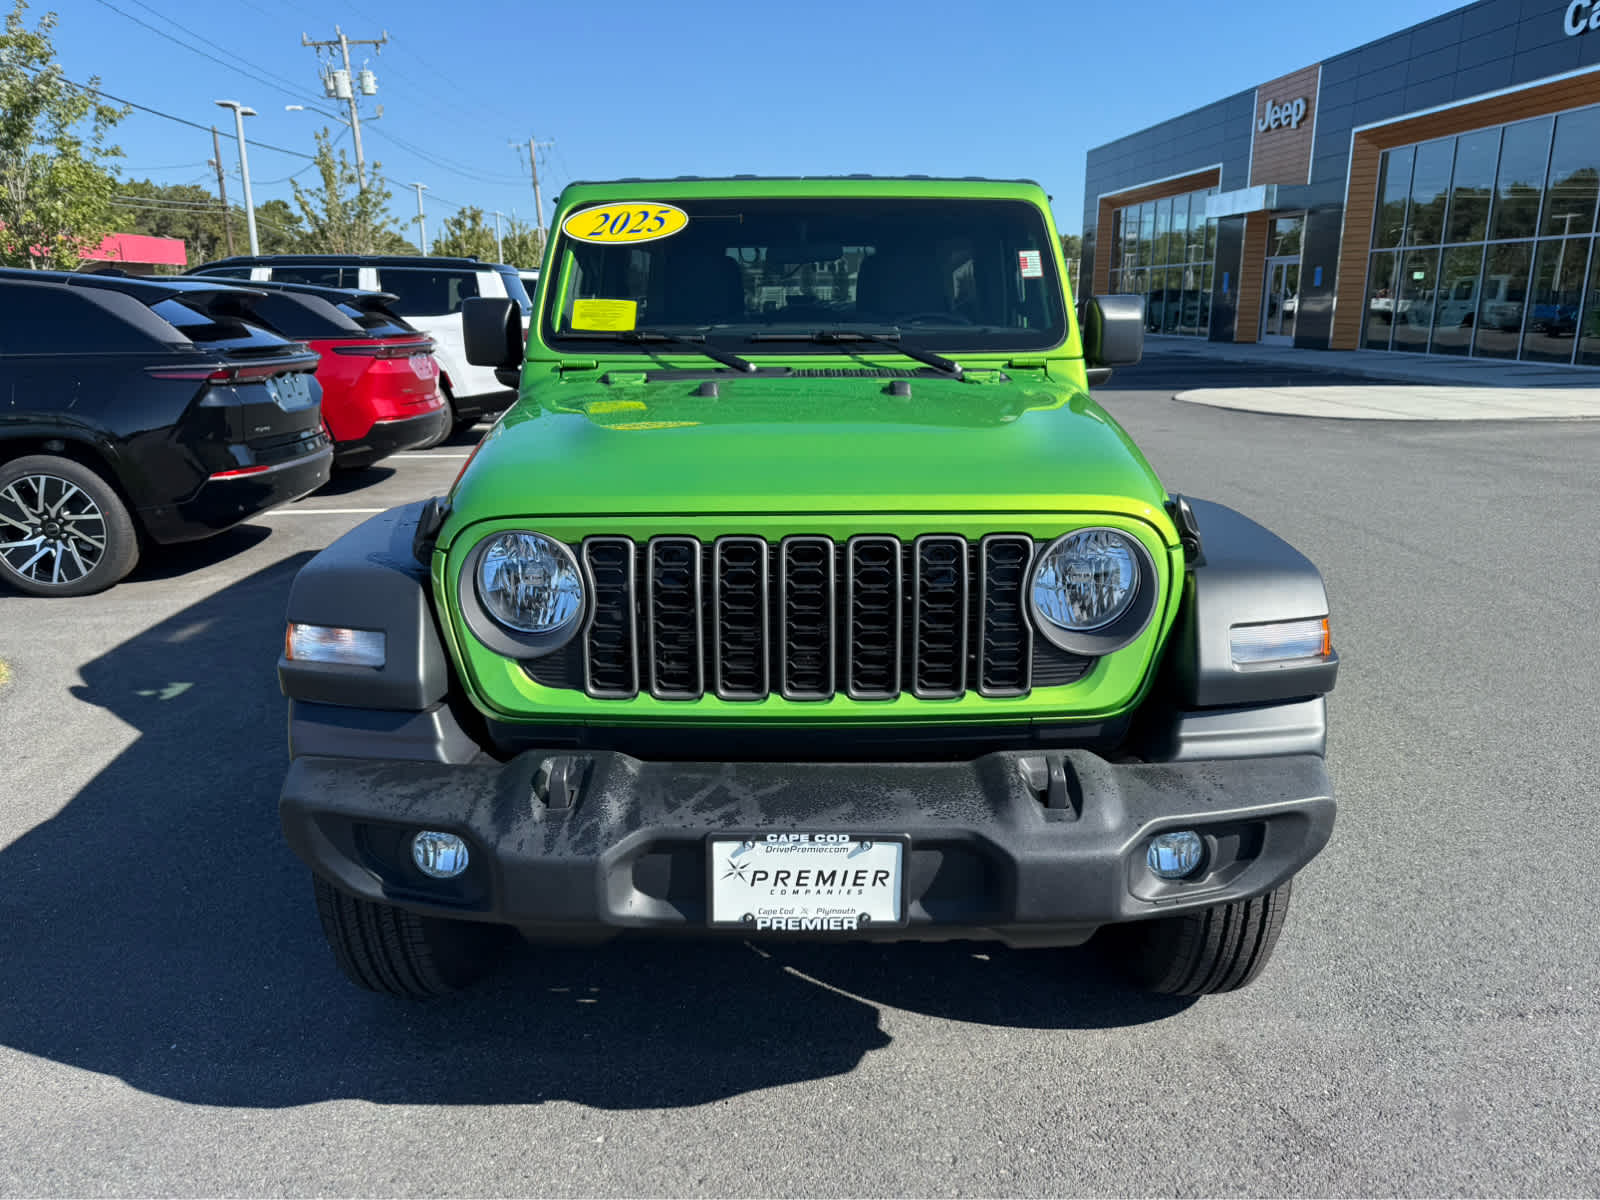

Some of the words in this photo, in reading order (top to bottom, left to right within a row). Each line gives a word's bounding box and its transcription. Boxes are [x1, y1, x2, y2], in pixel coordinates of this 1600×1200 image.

[1257, 97, 1306, 132] Jeep
[587, 209, 672, 237] 2025
[766, 833, 810, 843] CAPE
[814, 833, 850, 843] COD
[765, 845, 849, 854] DrivePremier.com
[750, 870, 890, 887] PREMIER
[758, 907, 779, 915] Cape
[780, 907, 794, 915] Cod
[816, 907, 856, 916] Plymouth
[756, 918, 858, 931] PREMIER
